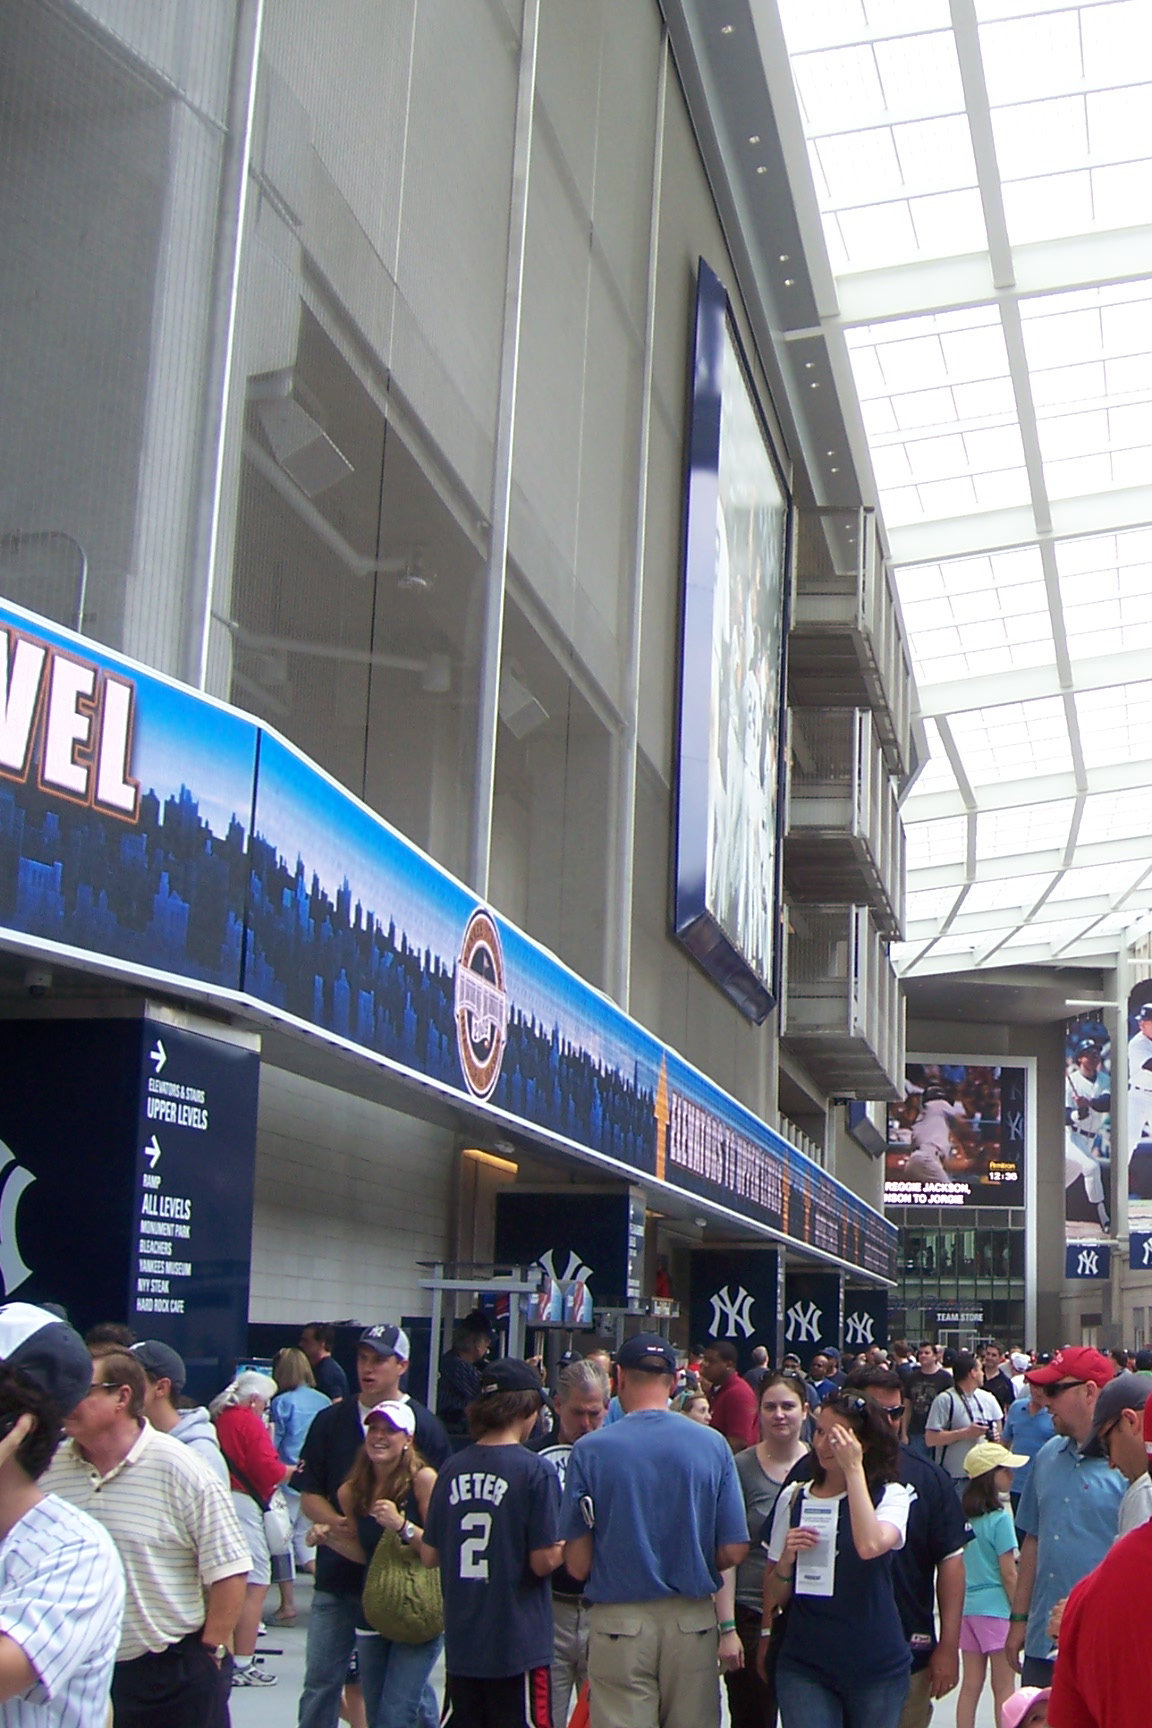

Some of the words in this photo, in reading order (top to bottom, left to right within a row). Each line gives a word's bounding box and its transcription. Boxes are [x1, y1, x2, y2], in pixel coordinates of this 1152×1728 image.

[148, 1077, 180, 1099] ELEVATORS
[186, 1087, 206, 1104] STAIRS
[147, 1097, 176, 1124] UPPER
[178, 1104, 208, 1131] LEVELS
[142, 1173, 161, 1189] RAMP
[885, 1181, 922, 1192] REGGIE
[141, 1194, 158, 1216] ALL
[159, 1196, 192, 1220] LEVELS
[913, 1194, 927, 1204] TO
[140, 1219, 175, 1237] MONUMENT
[175, 1224, 191, 1239] PARK
[139, 1239, 172, 1256] BLEACHERS
[139, 1259, 166, 1275] YANKEES
[166, 1261, 192, 1277] MUSEUM
[1077, 1250, 1099, 1275] NY
[137, 1278, 151, 1293] NYY
[151, 1279, 170, 1294] STEAK
[136, 1298, 153, 1312] HARD
[154, 1299, 170, 1313] ROCK
[170, 1300, 185, 1314] CAFE
[708, 1285, 755, 1338] NY
[936, 1312, 958, 1322] TEAM
[960, 1312, 984, 1322] STORE
[785, 1301, 823, 1342] NY
[846, 1311, 875, 1344] NY
[449, 1472, 509, 1507] JETER
[460, 1512, 492, 1578] 2
